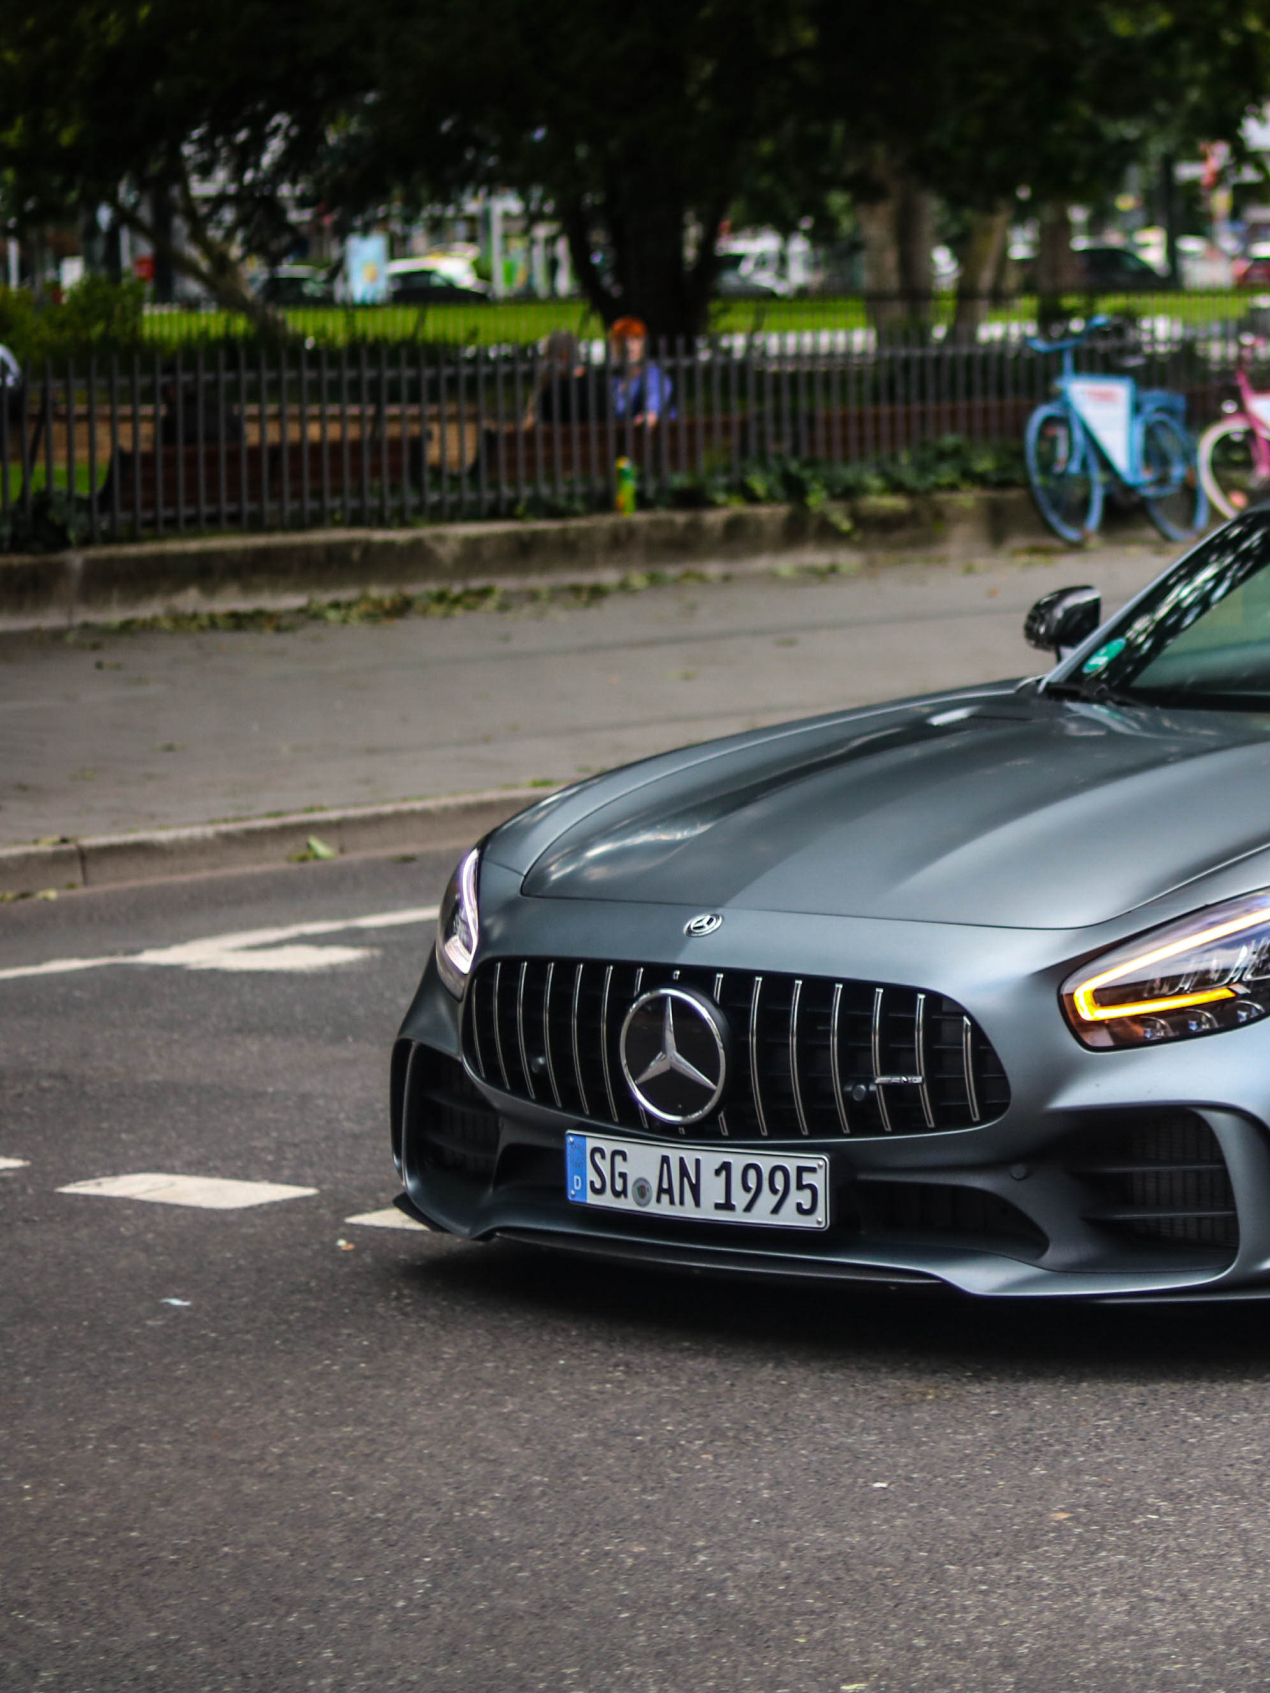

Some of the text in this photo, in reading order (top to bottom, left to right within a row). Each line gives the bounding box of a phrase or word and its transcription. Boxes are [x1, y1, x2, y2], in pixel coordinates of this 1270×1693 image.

[573, 1175, 582, 1191] D
[588, 1146, 819, 1216] SG AN 1995
